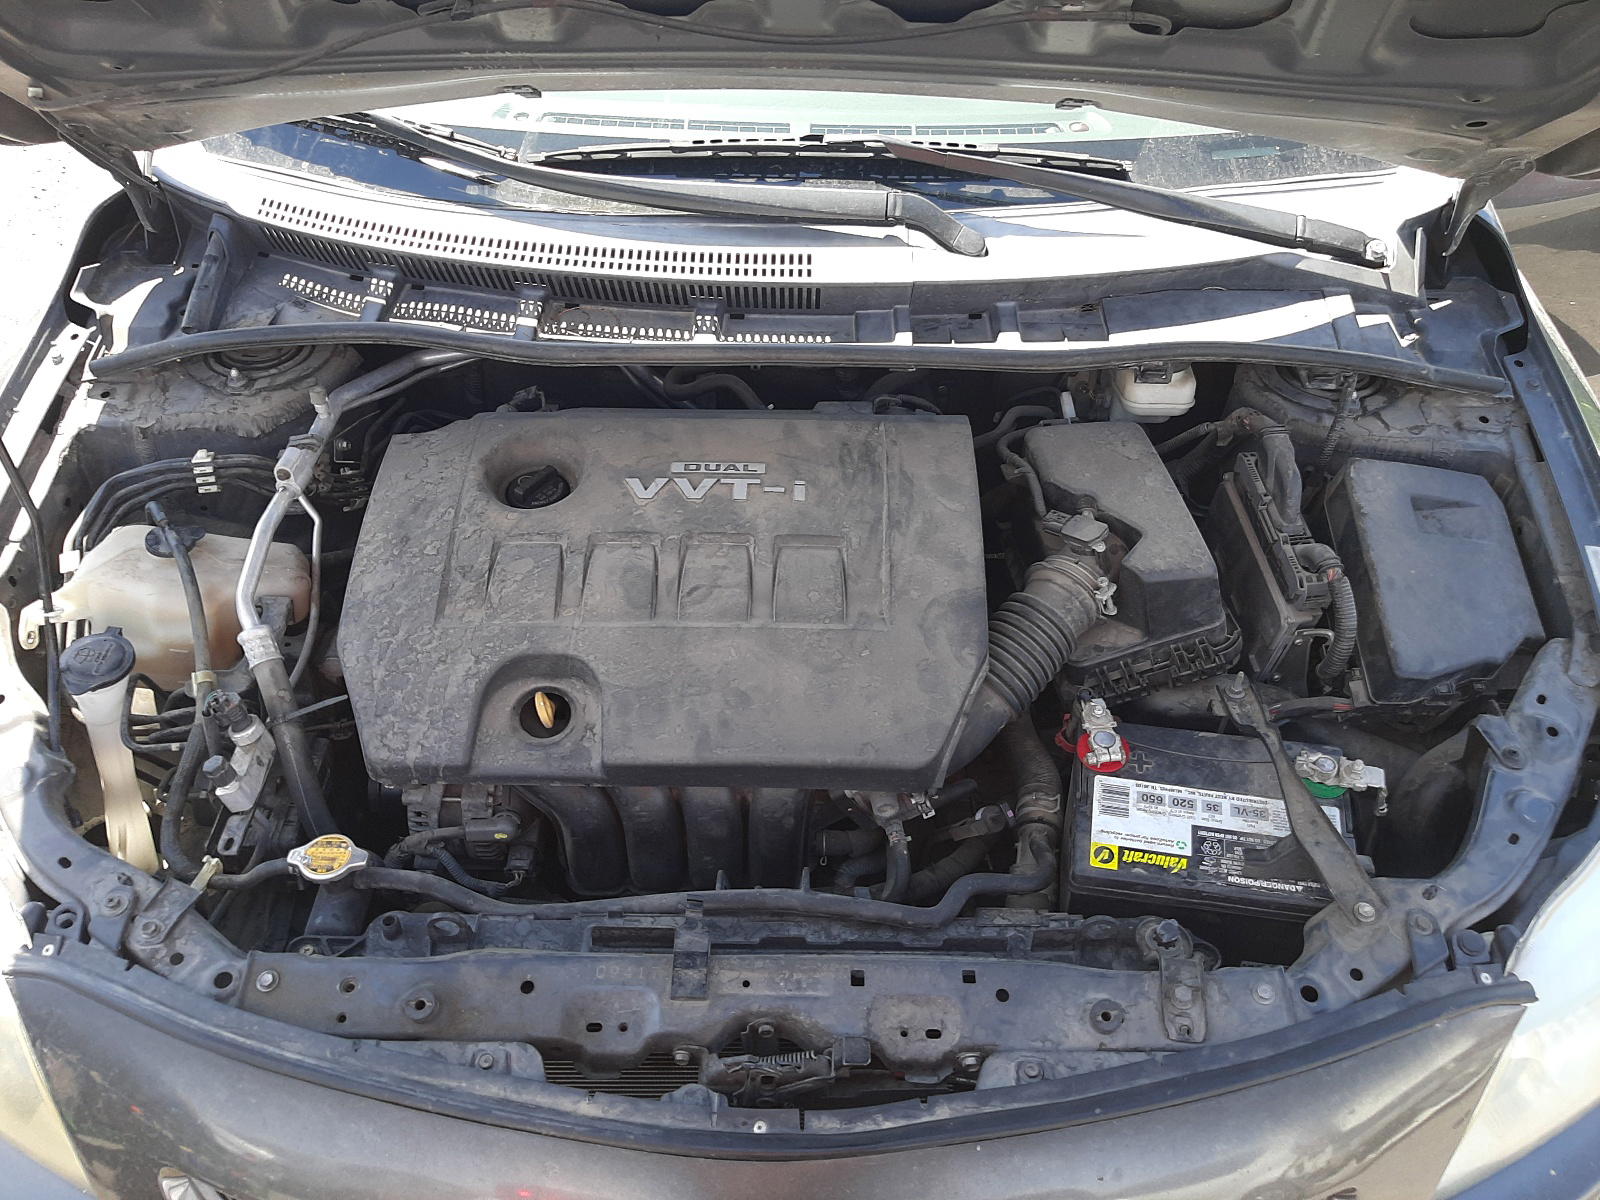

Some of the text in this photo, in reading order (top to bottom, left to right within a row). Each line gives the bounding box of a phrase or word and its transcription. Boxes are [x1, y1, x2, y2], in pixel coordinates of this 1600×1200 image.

[683, 462, 758, 472] DUAL
[624, 477, 806, 502] VVT-i
[1141, 793, 1163, 805] 650
[1172, 797, 1194, 809] 520
[1206, 803, 1219, 812] 35
[1233, 807, 1265, 818] 35-VL
[1122, 850, 1188, 873] Valucraft
